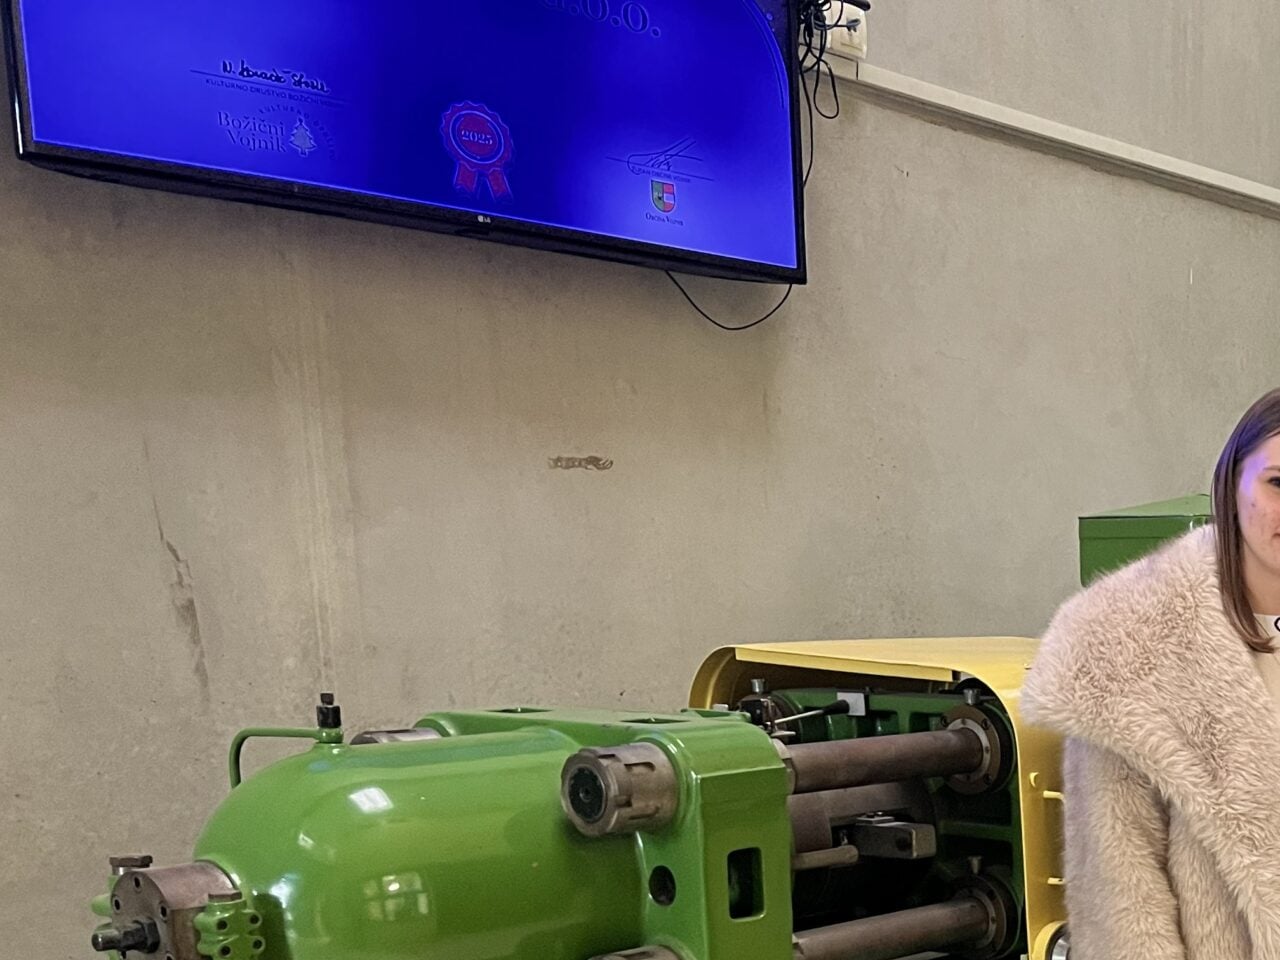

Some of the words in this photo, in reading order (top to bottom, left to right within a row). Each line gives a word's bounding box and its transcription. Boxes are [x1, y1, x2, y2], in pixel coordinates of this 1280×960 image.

[542, 0, 661, 38] .o.o.
[205, 78, 249, 92] KULTURNO
[217, 110, 286, 136] Božični
[226, 129, 287, 152] Vojnik
[461, 129, 493, 145] 2025
